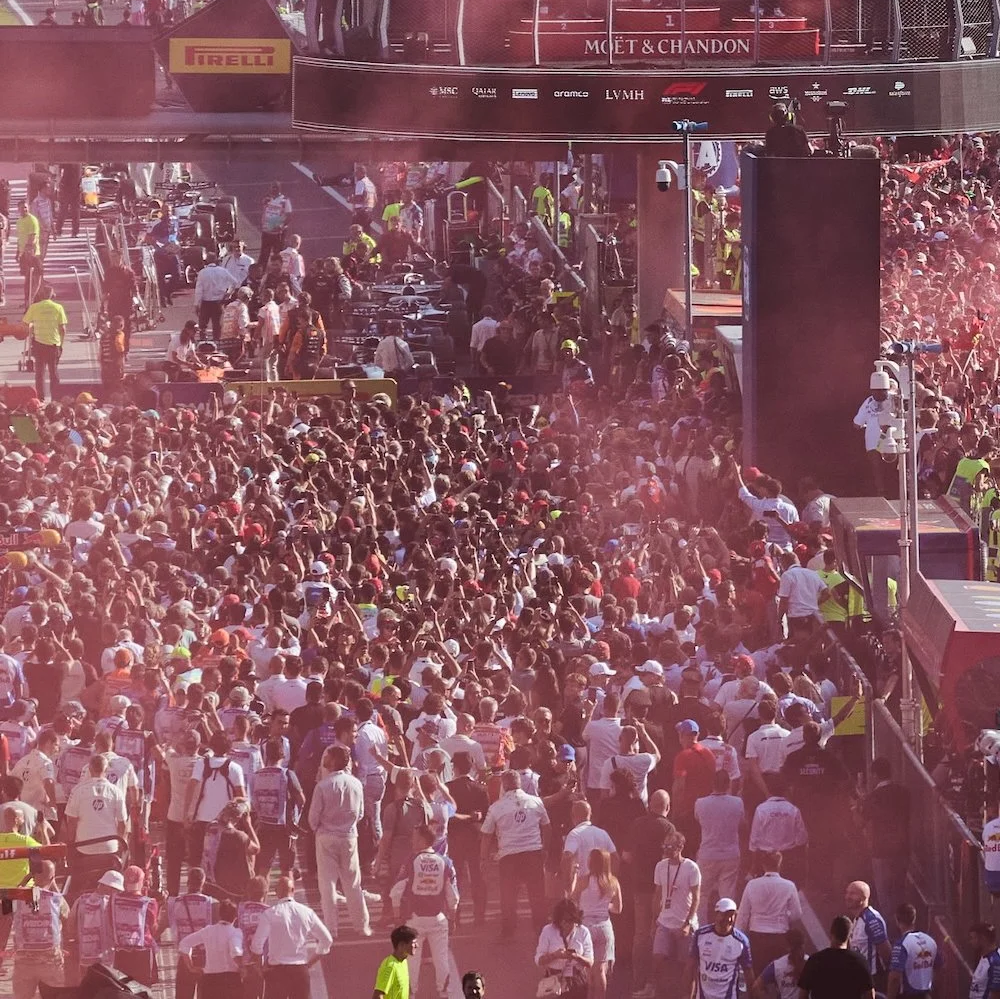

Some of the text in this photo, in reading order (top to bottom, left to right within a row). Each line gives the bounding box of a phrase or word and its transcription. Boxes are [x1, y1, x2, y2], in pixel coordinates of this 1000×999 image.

[665, 15, 675, 27] 1
[767, 21, 774, 29] 3
[584, 36, 750, 54] MOËT & CHANDON
[185, 46, 275, 67] PIRELLI
[439, 86, 458, 95] MSC
[472, 87, 497, 95] QATAR
[554, 90, 589, 98] aramco
[605, 89, 644, 100] LVMH
[768, 85, 789, 95] aws
[847, 86, 872, 94] DHL
[514, 811, 526, 823] hp
[420, 864, 439, 872] VISA
[704, 961, 728, 973] VISA
